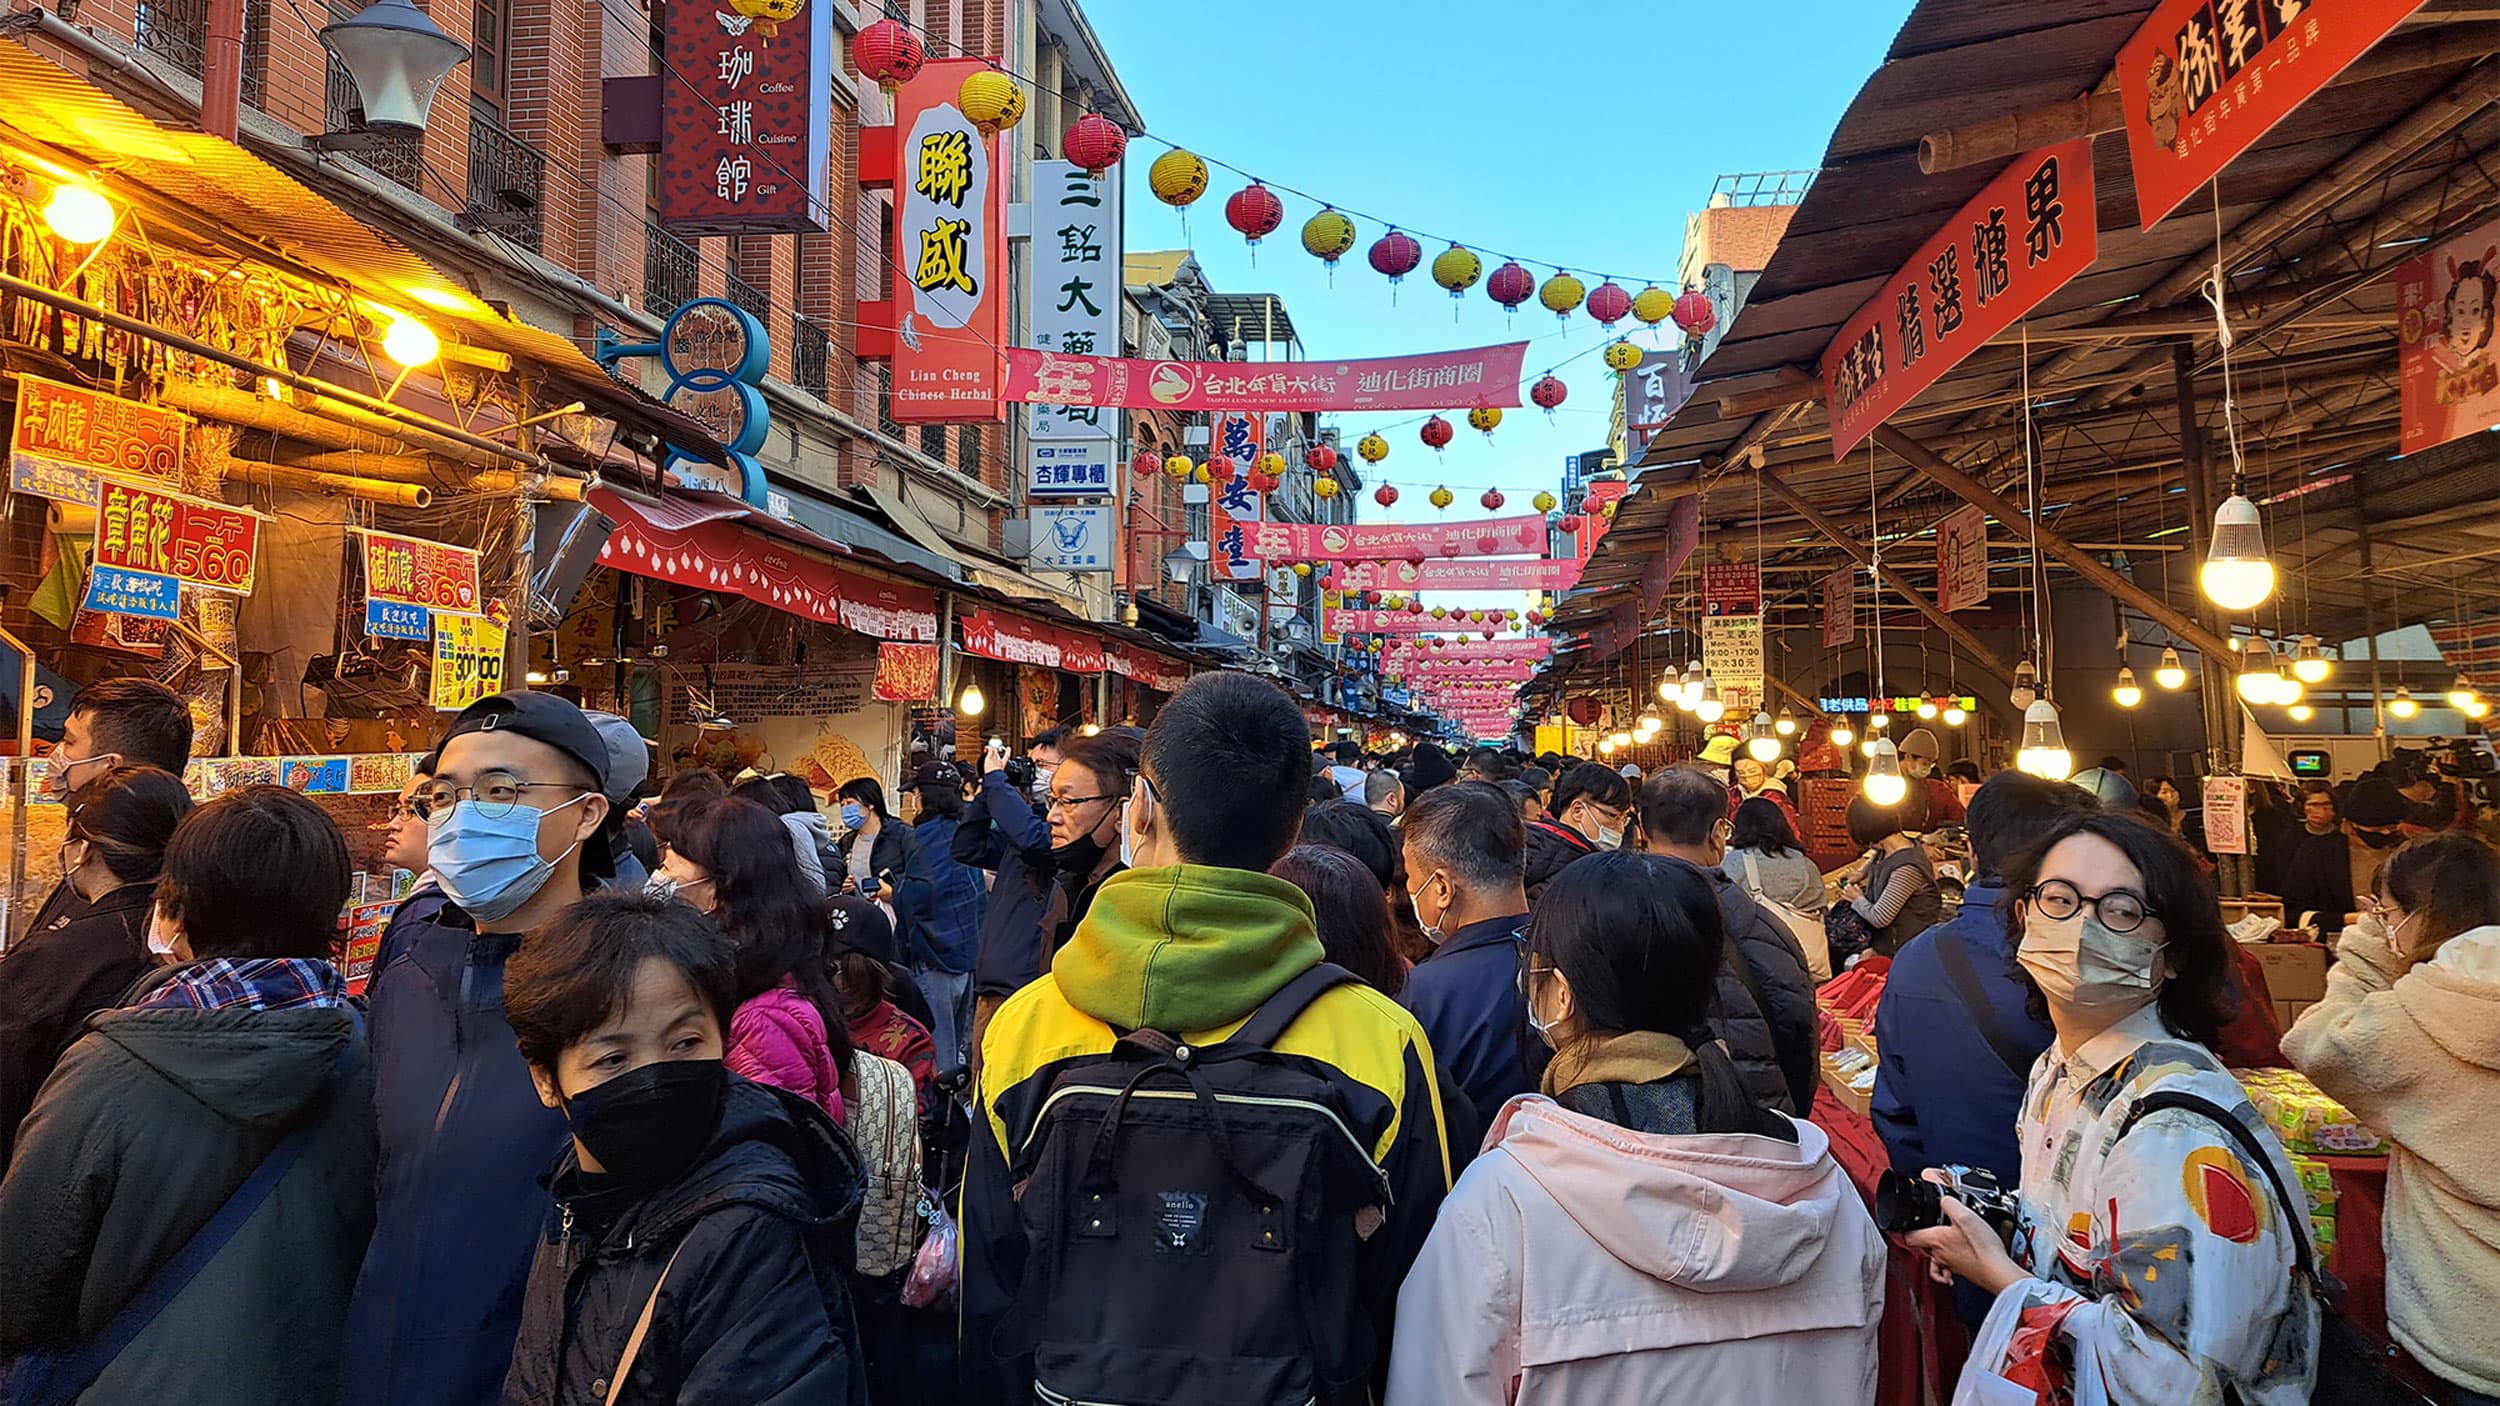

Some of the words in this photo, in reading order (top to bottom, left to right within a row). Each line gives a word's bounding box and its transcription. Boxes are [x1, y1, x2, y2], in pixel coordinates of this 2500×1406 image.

[759, 82, 795, 95] Coffee
[716, 45, 753, 201] 珈琲館
[758, 133, 798, 145] Cuisine
[756, 184, 777, 195] Gift
[915, 130, 978, 297] 聯盛
[1896, 155, 2064, 372] 精選糖果
[910, 369, 937, 382] Lian
[942, 369, 981, 384] Cheng
[1203, 371, 1337, 396] 台北年貨大街
[1357, 360, 1484, 393] 迪化街商圈
[898, 388, 945, 401] Chinese
[950, 387, 992, 401] Herbal
[89, 428, 178, 477] 560
[1036, 463, 1106, 485] 杏輝專櫃
[188, 515, 244, 543] 一斤
[173, 537, 251, 587] 560
[415, 573, 476, 609] 360
[1710, 602, 1719, 615] P
